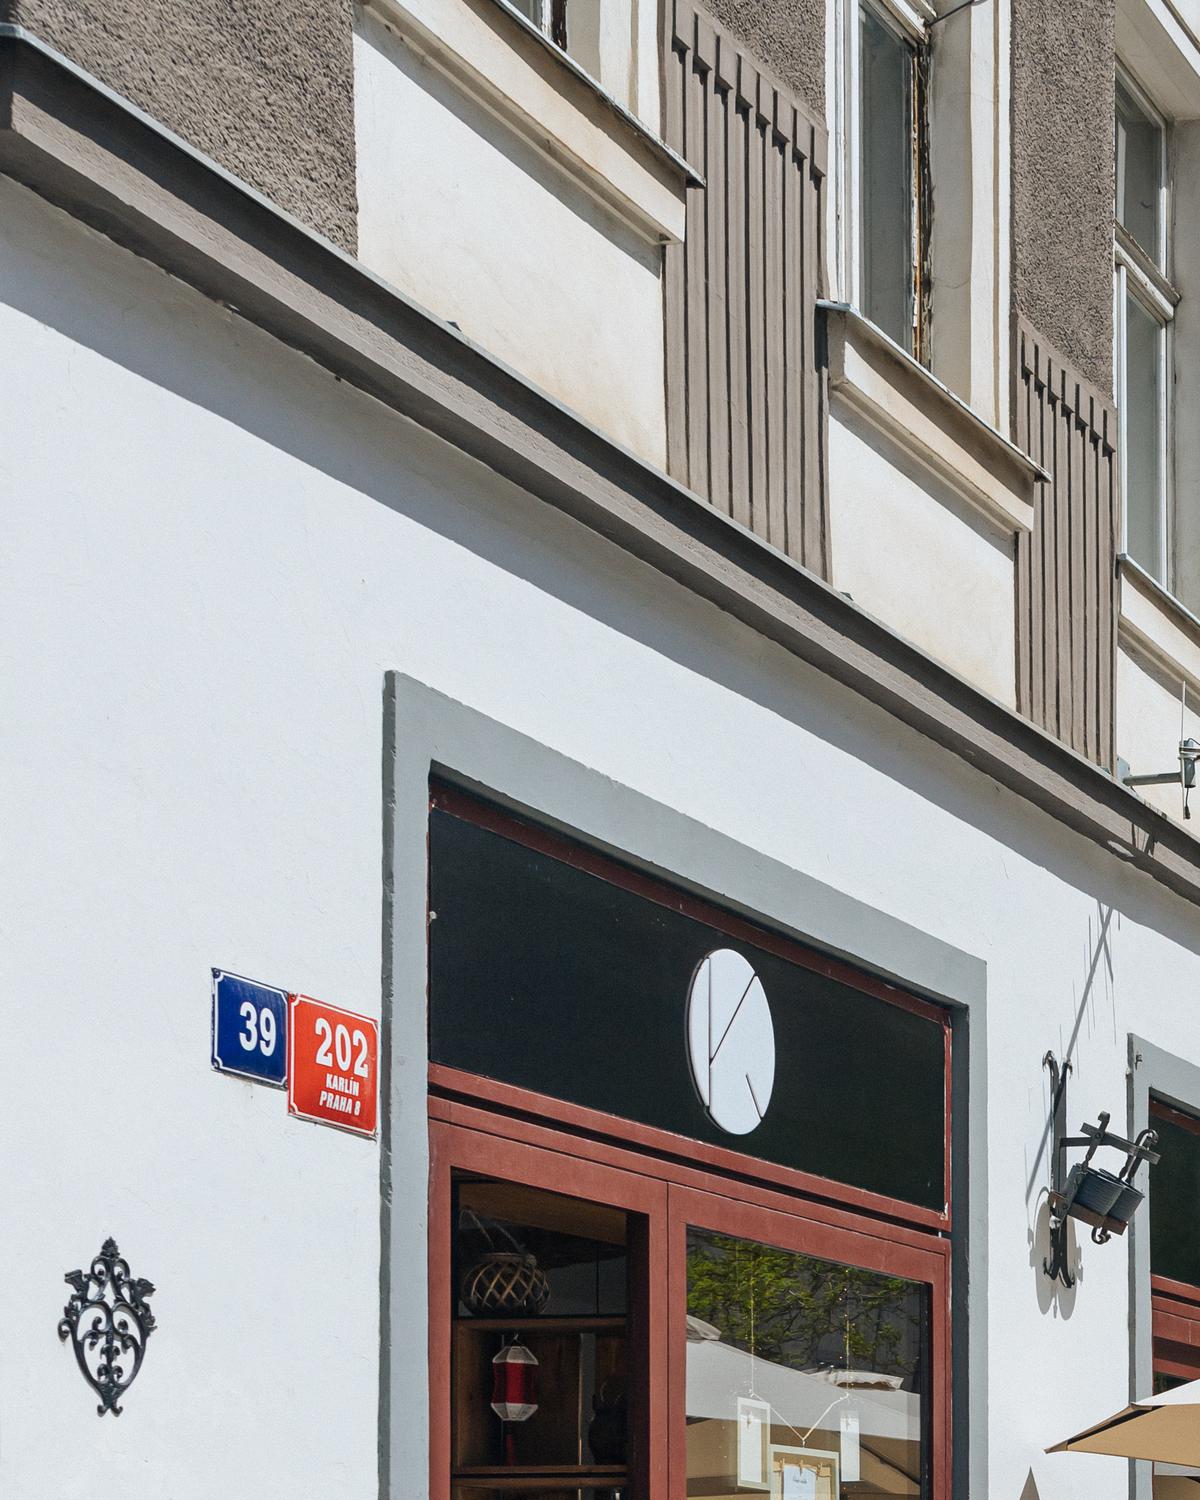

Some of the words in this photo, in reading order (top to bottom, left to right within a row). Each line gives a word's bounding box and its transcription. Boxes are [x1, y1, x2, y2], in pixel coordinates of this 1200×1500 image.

[239, 1001, 276, 1057] 39
[314, 1017, 369, 1078] 202
[319, 1090, 352, 1115] PRAHA
[353, 1101, 361, 1116] 8
[326, 1073, 360, 1097] KARLÍN
